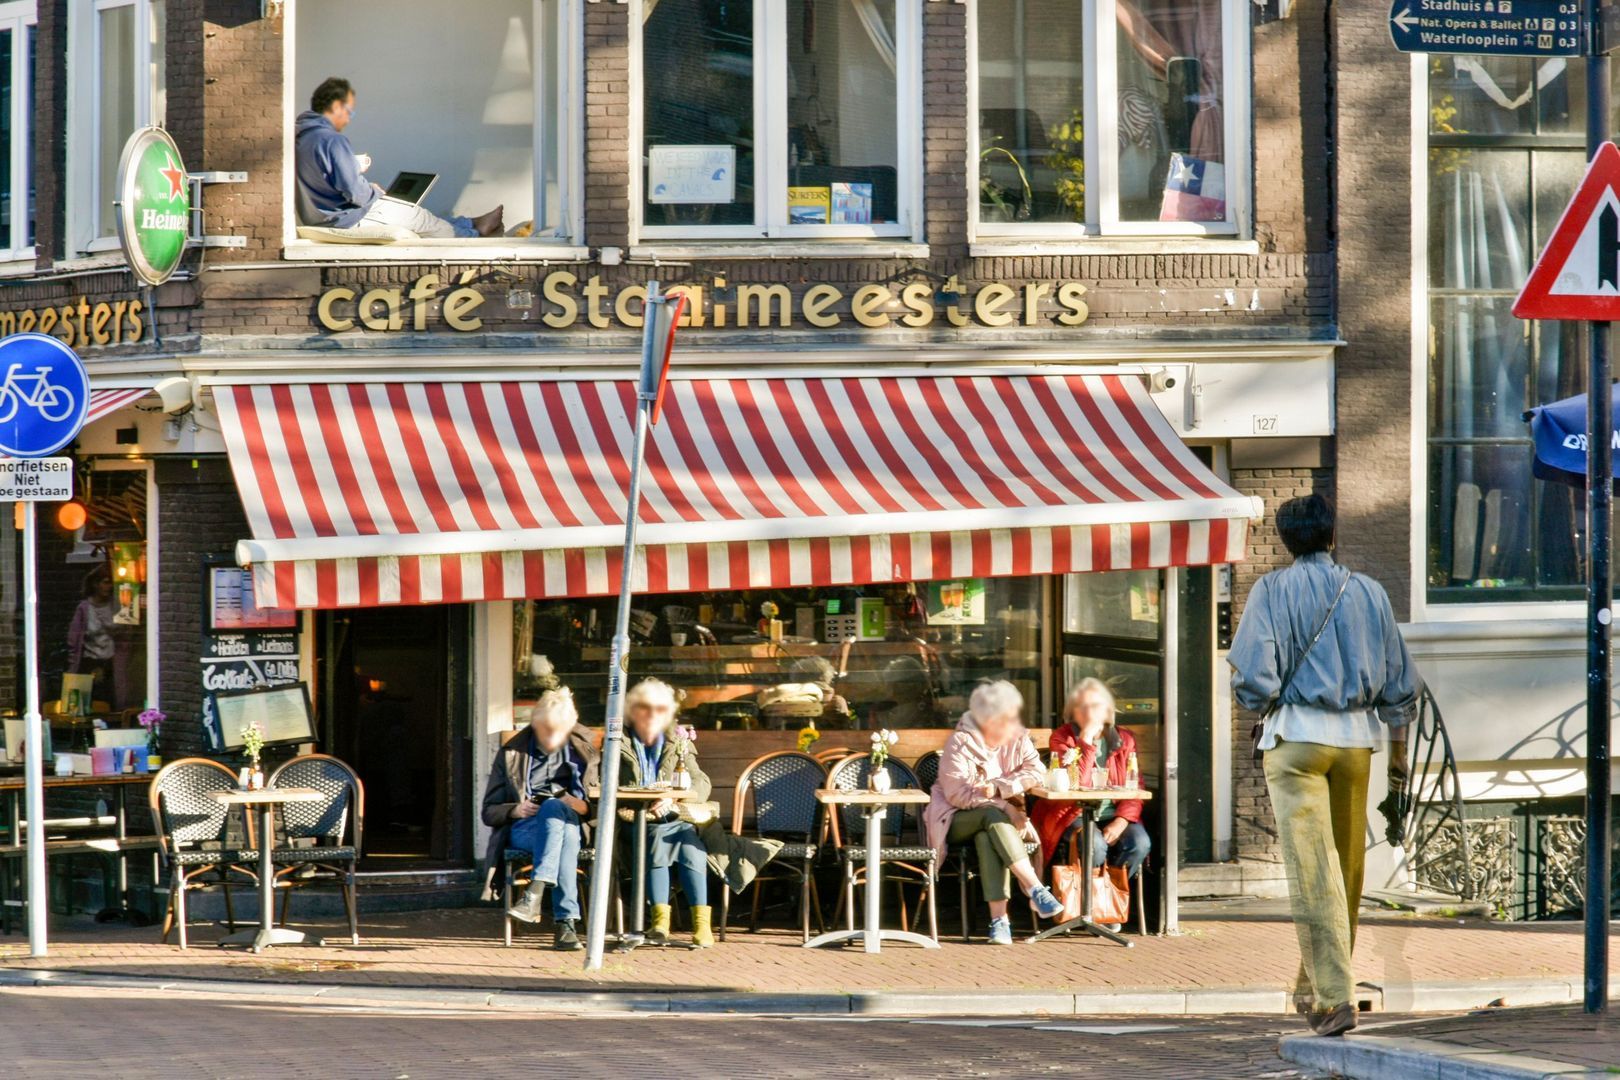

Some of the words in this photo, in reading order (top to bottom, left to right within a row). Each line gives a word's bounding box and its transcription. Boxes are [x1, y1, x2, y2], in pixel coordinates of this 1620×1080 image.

[1421, 0, 1481, 12] Stadhuis
[1559, 4, 1576, 14] 0,3
[1420, 18, 1443, 28] Nat.
[1445, 18, 1477, 30] Opera
[1480, 19, 1487, 29] &
[1491, 19, 1522, 30] Ballet
[1420, 32, 1518, 48] Waterlooplein
[1559, 38, 1576, 48] 0,3
[317, 269, 486, 331] café
[1257, 418, 1277, 431] 127
[0, 460, 68, 472] norfietsen
[15, 473, 40, 485] Niet
[0, 486, 69, 499] oegestaan
